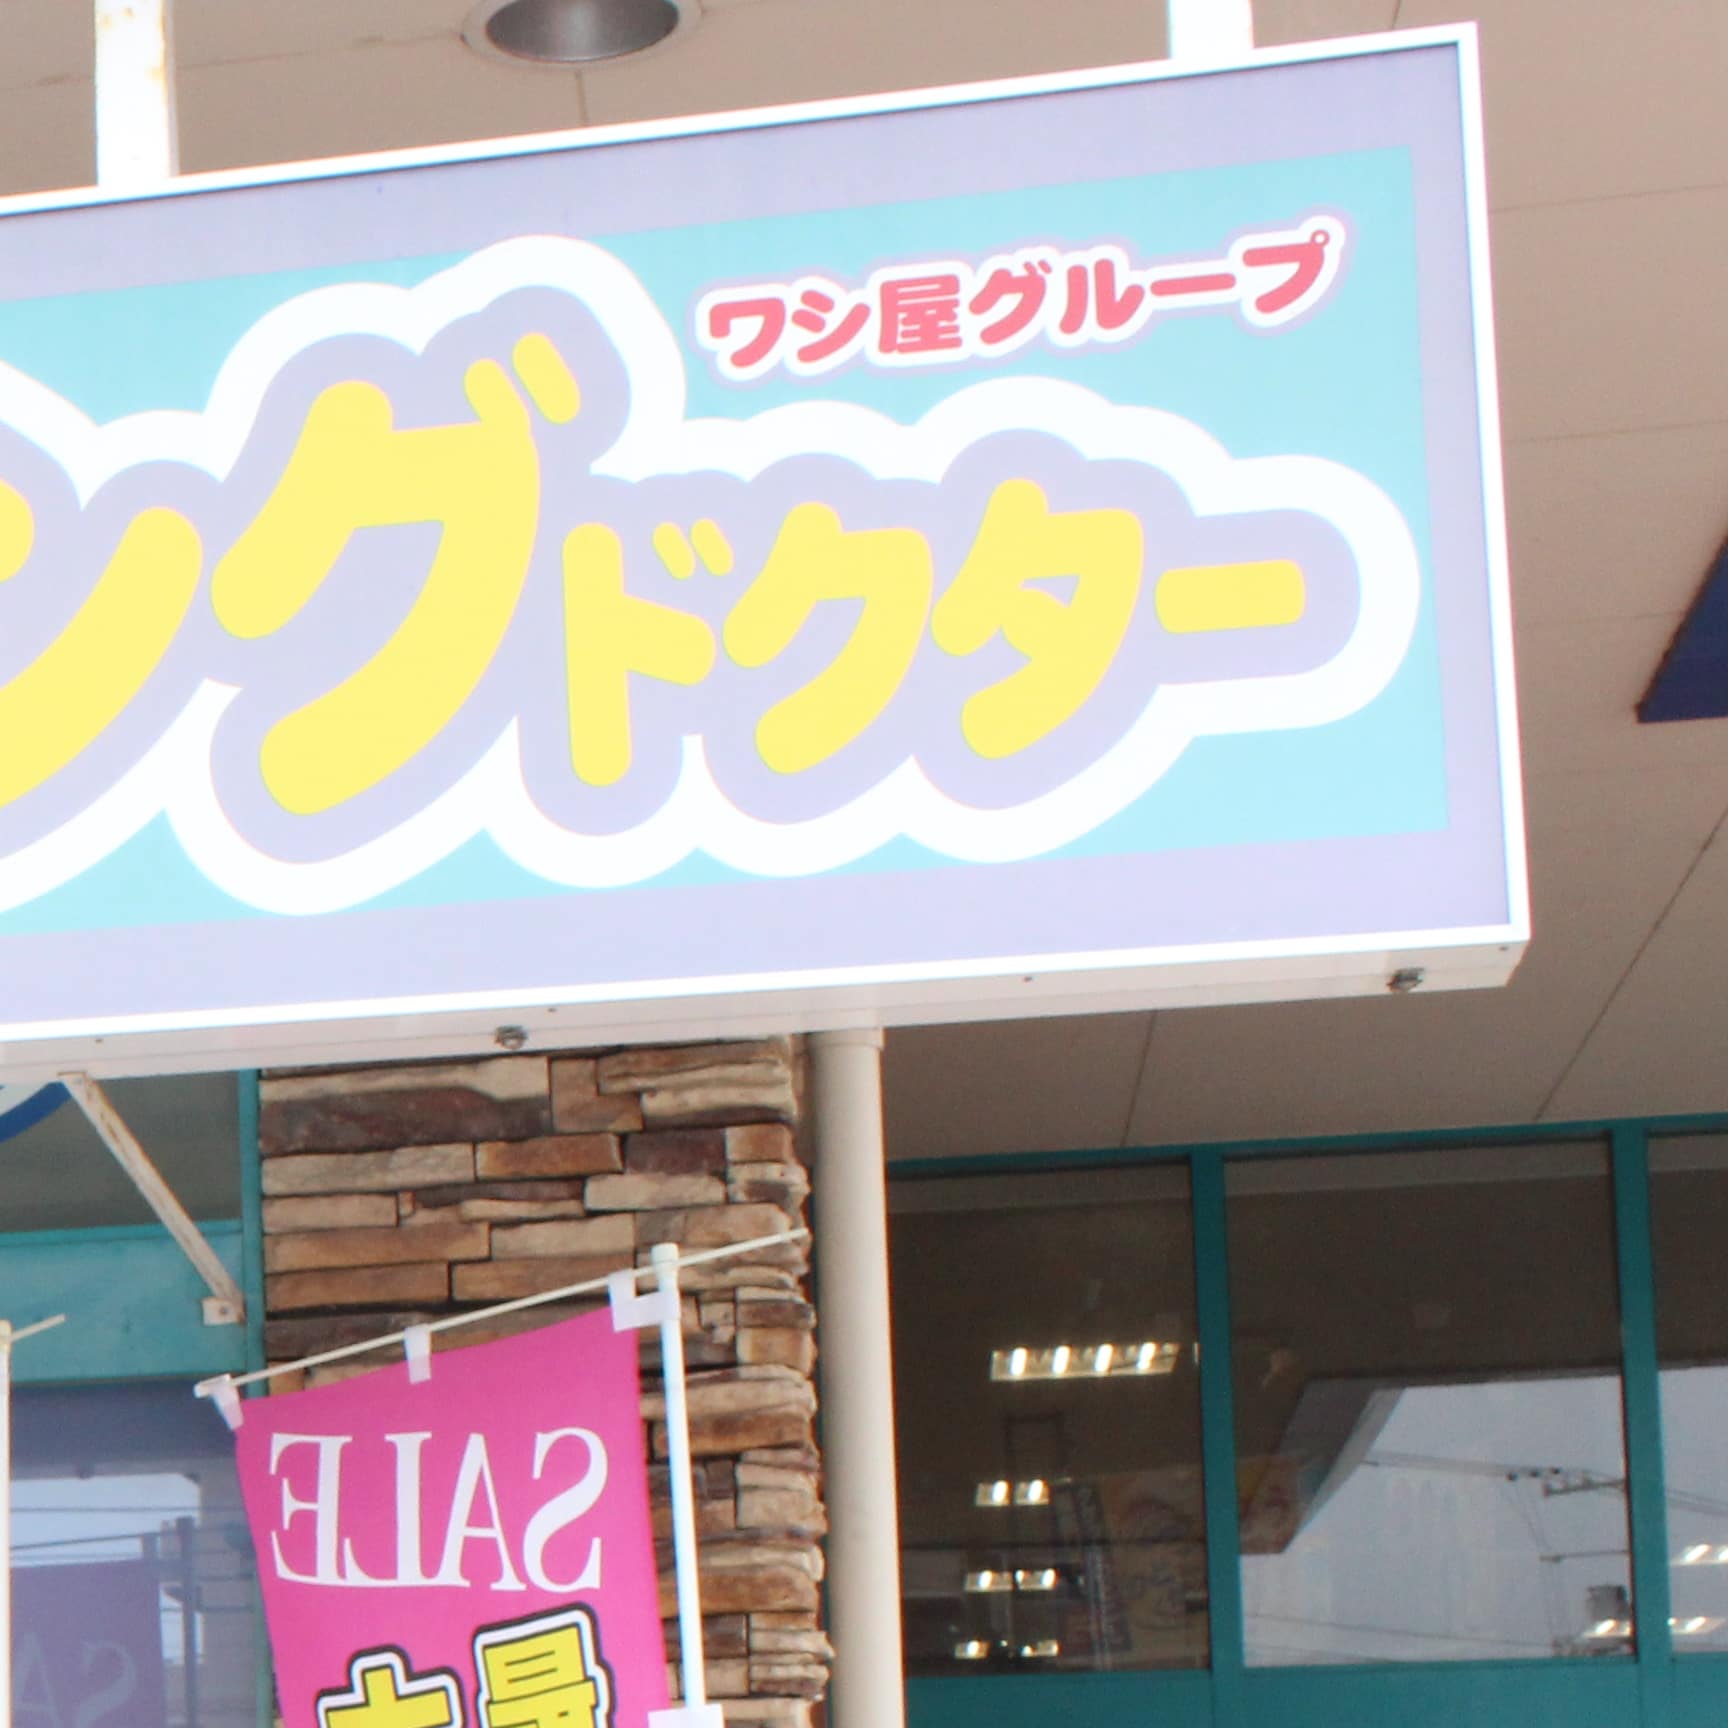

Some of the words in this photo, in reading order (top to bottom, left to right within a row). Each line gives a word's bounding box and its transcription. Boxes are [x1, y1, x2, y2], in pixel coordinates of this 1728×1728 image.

[706, 226, 1332, 369] ワシ屋グループ
